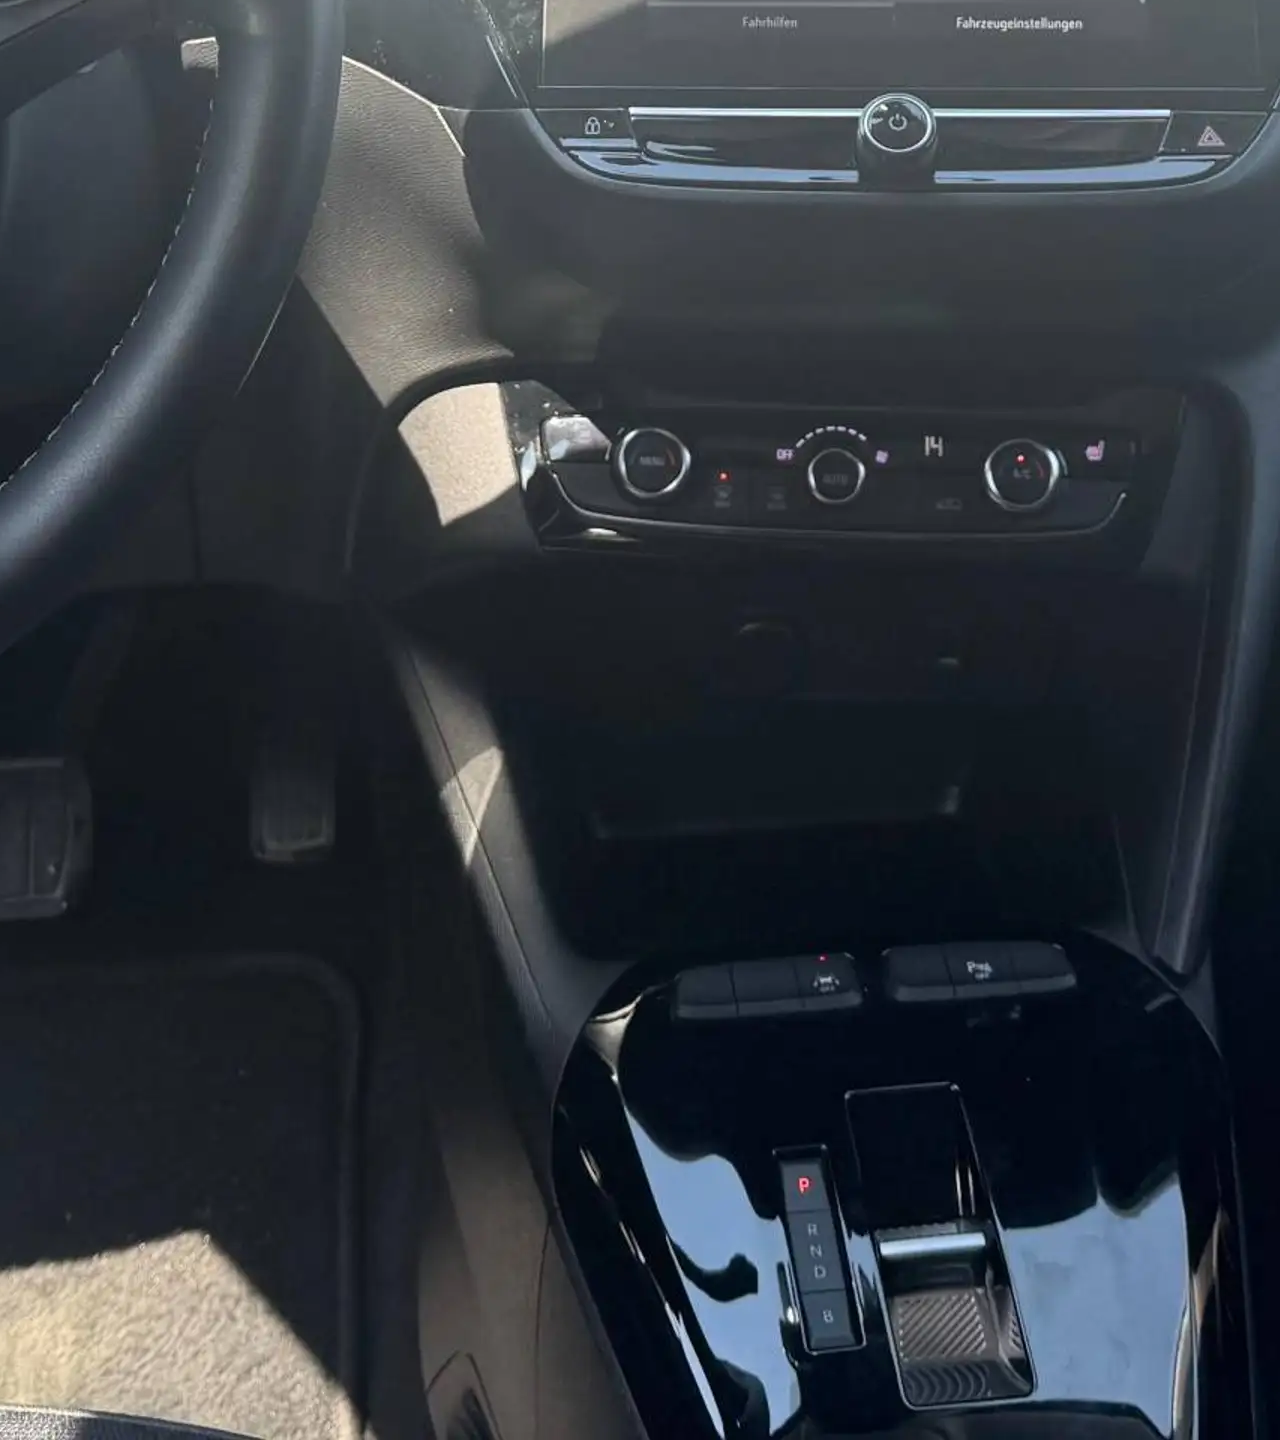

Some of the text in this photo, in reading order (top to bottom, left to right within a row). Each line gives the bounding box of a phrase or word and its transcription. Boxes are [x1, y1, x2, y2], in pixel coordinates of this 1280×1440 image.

[742, 16, 798, 29] Fahrhilfen
[956, 16, 1083, 32] Fahrzeugeinstellungen
[925, 435, 943, 457] 14
[776, 448, 794, 460] OFF
[799, 1177, 810, 1193] P
[808, 1224, 818, 1236] R
[810, 1245, 822, 1257] N
[814, 1266, 826, 1278] D
